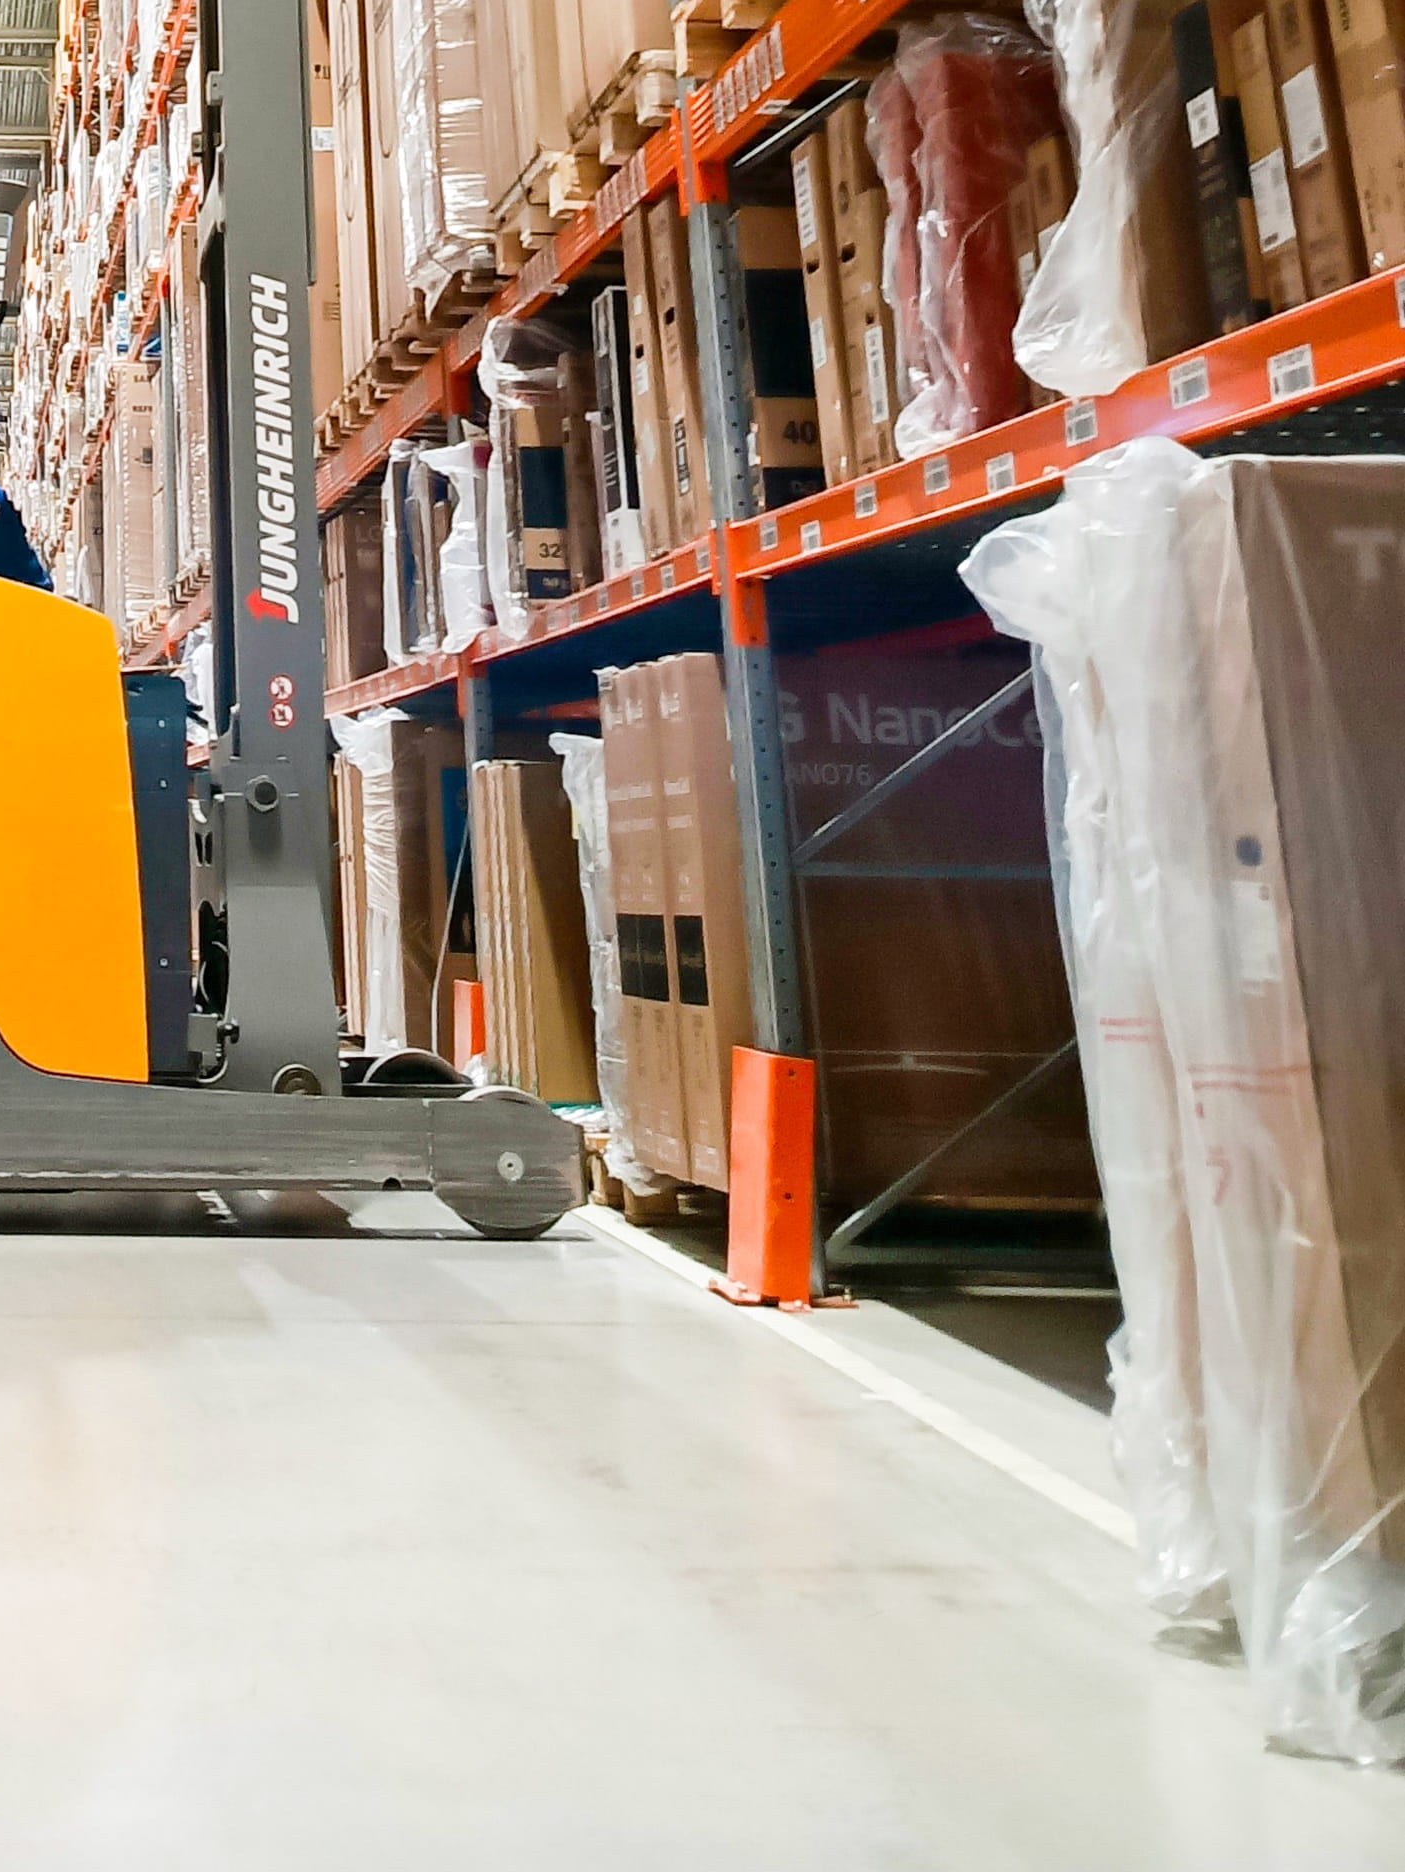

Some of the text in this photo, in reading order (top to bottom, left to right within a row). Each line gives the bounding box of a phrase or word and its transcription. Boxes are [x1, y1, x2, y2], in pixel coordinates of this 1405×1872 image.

[783, 420, 818, 445] 40
[248, 273, 300, 624] JUNGHEINRICH
[539, 542, 562, 559] 32
